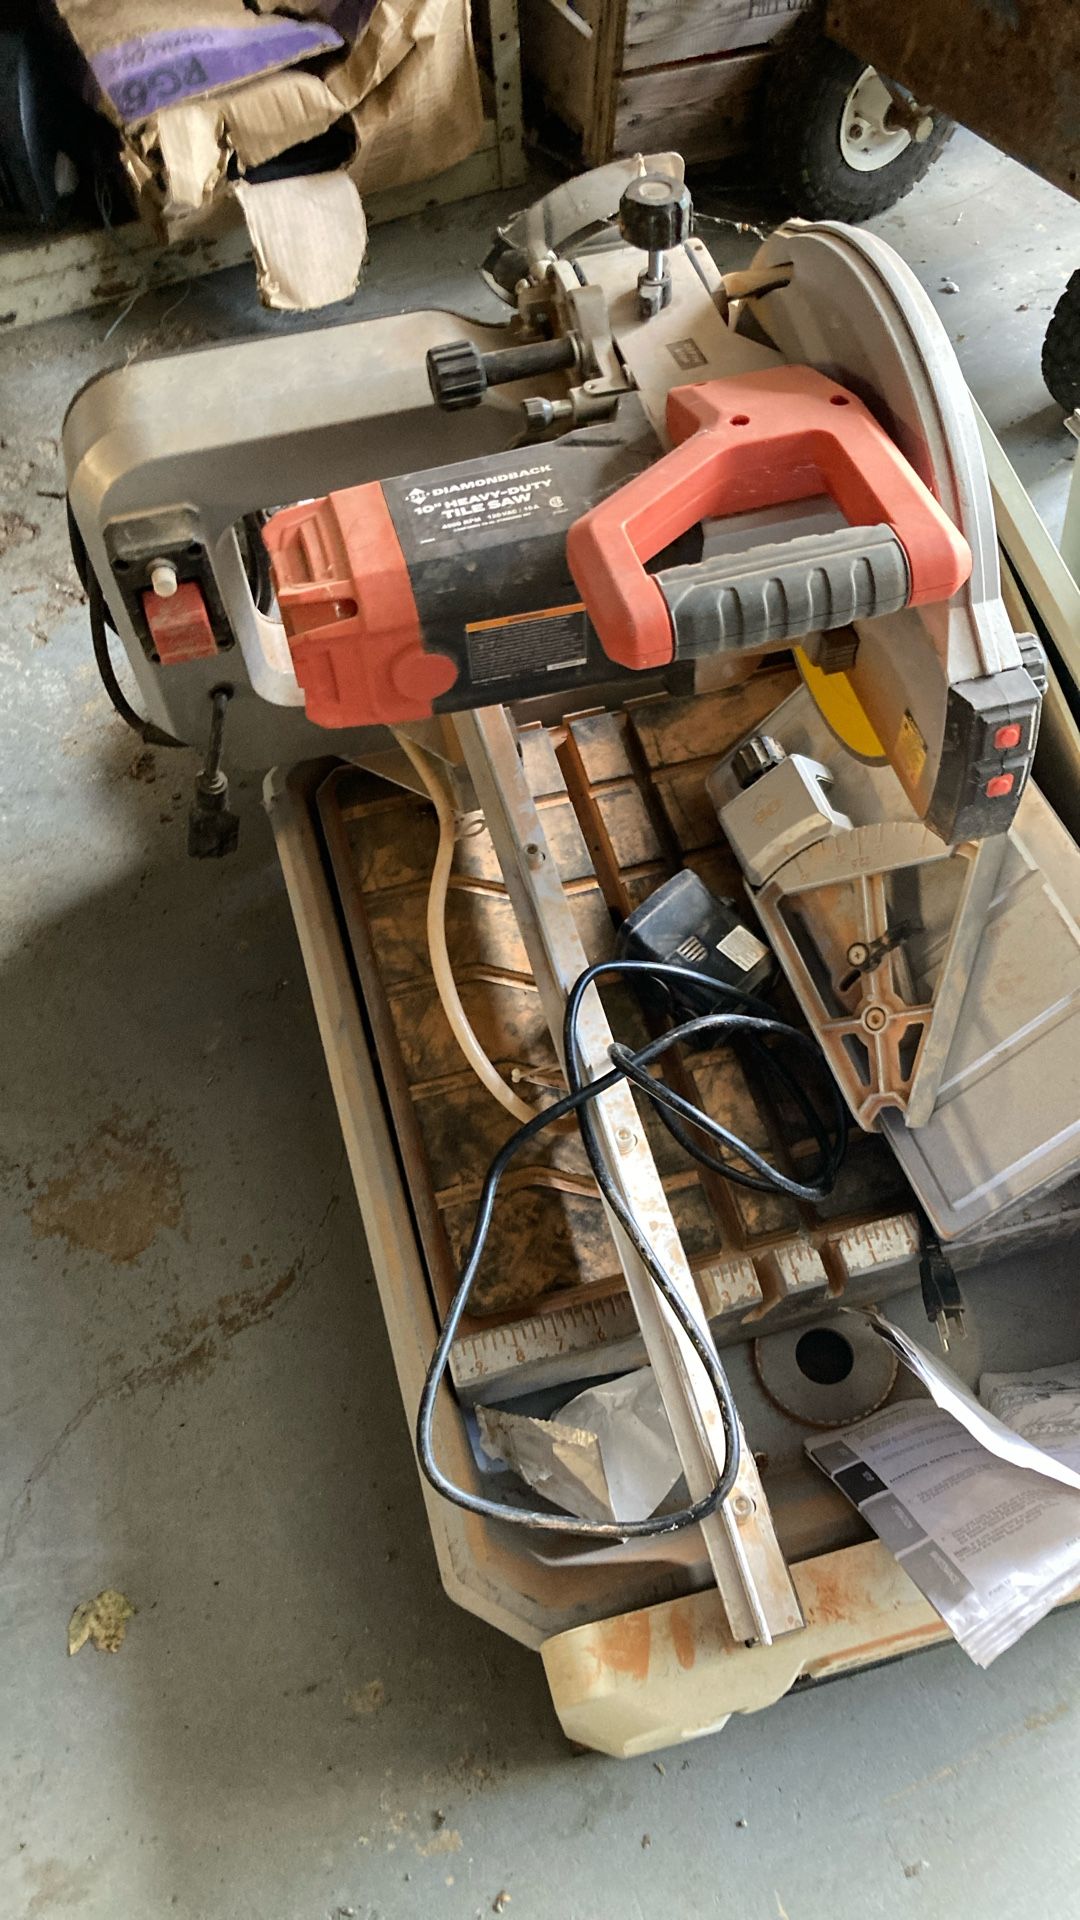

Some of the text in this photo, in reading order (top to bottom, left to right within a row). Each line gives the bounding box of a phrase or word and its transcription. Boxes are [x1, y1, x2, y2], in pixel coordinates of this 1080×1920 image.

[414, 502, 442, 516] 10"
[444, 479, 552, 509] HEAVY-DUTY
[432, 464, 553, 497] DIAMONDBACK
[441, 504, 486, 519] TILE
[488, 493, 532, 509] SAW
[516, 1348, 526, 1363] 8
[556, 1337, 563, 1351] 7
[597, 1326, 608, 1342] 6
